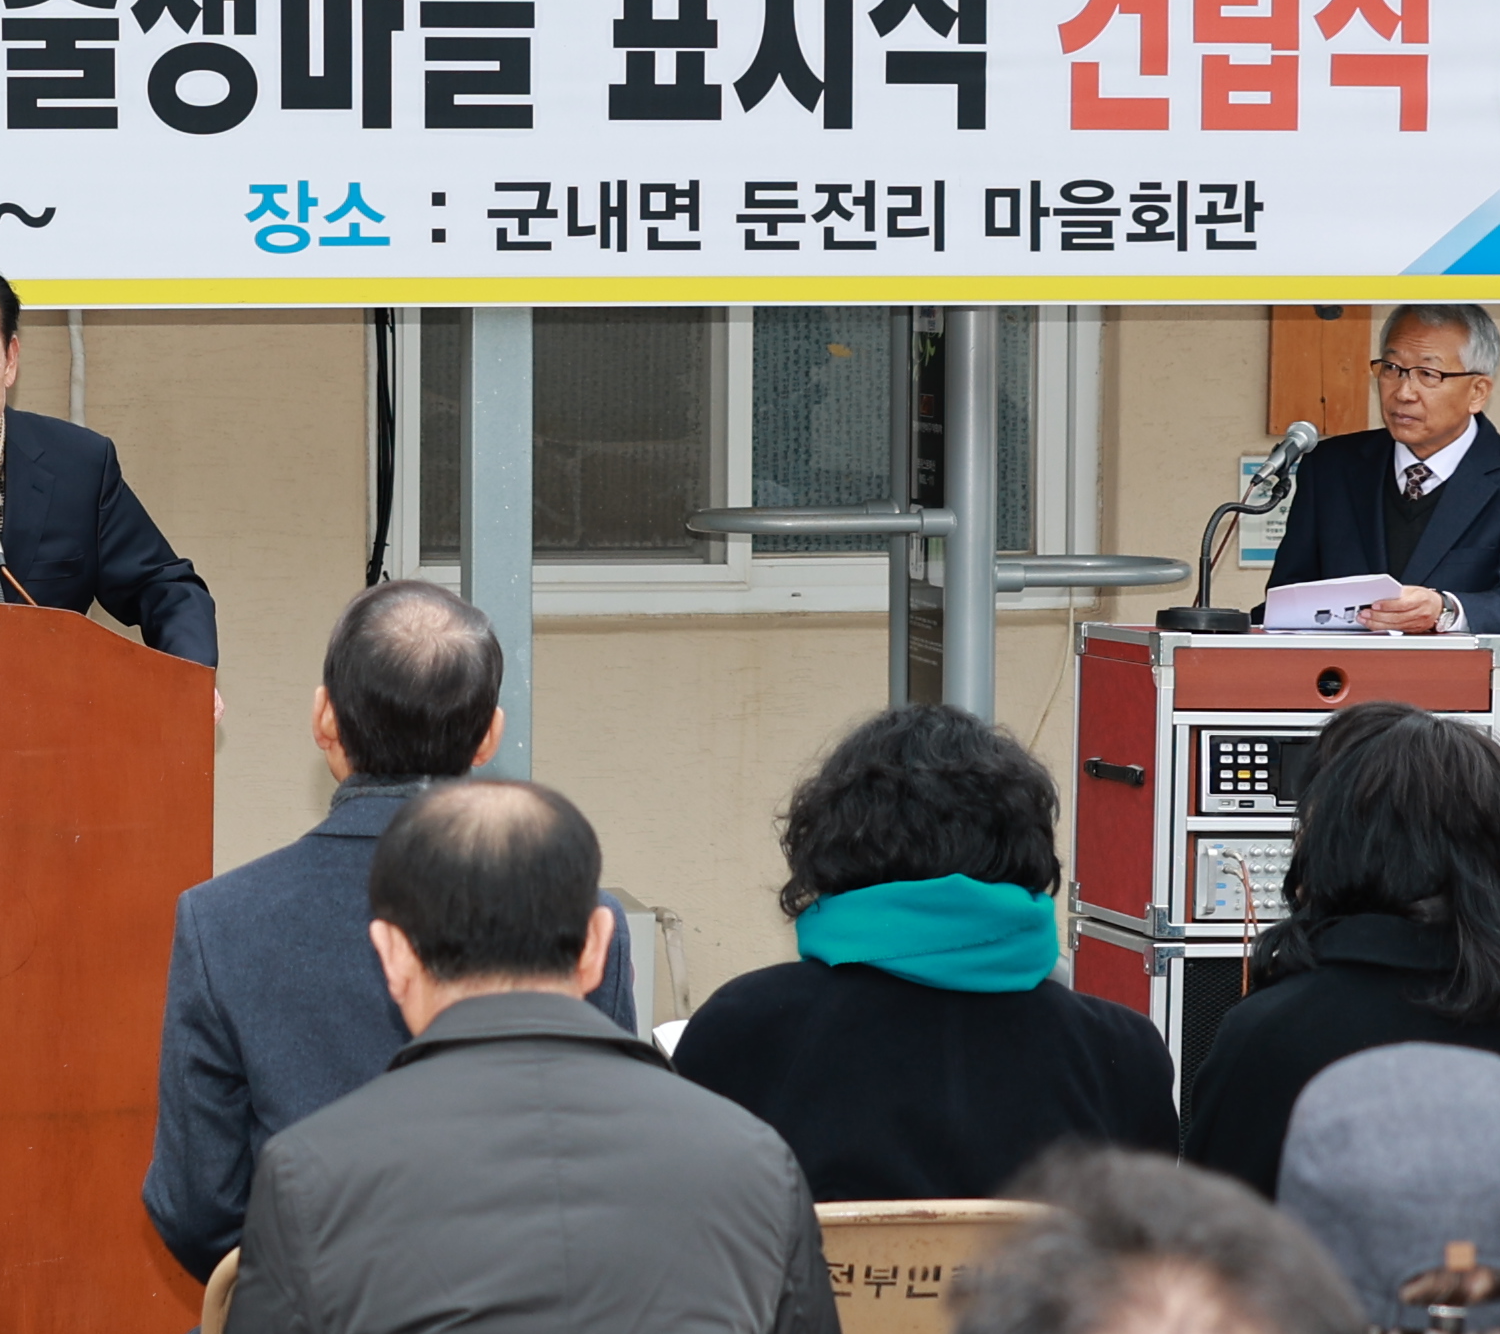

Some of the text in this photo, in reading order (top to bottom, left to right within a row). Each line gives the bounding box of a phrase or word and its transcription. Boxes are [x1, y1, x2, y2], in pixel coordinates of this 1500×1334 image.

[246, 180, 390, 254] 장소
[487, 180, 701, 252] 군내면
[736, 180, 945, 252] 둔전리
[985, 180, 1264, 252] 마을회관
